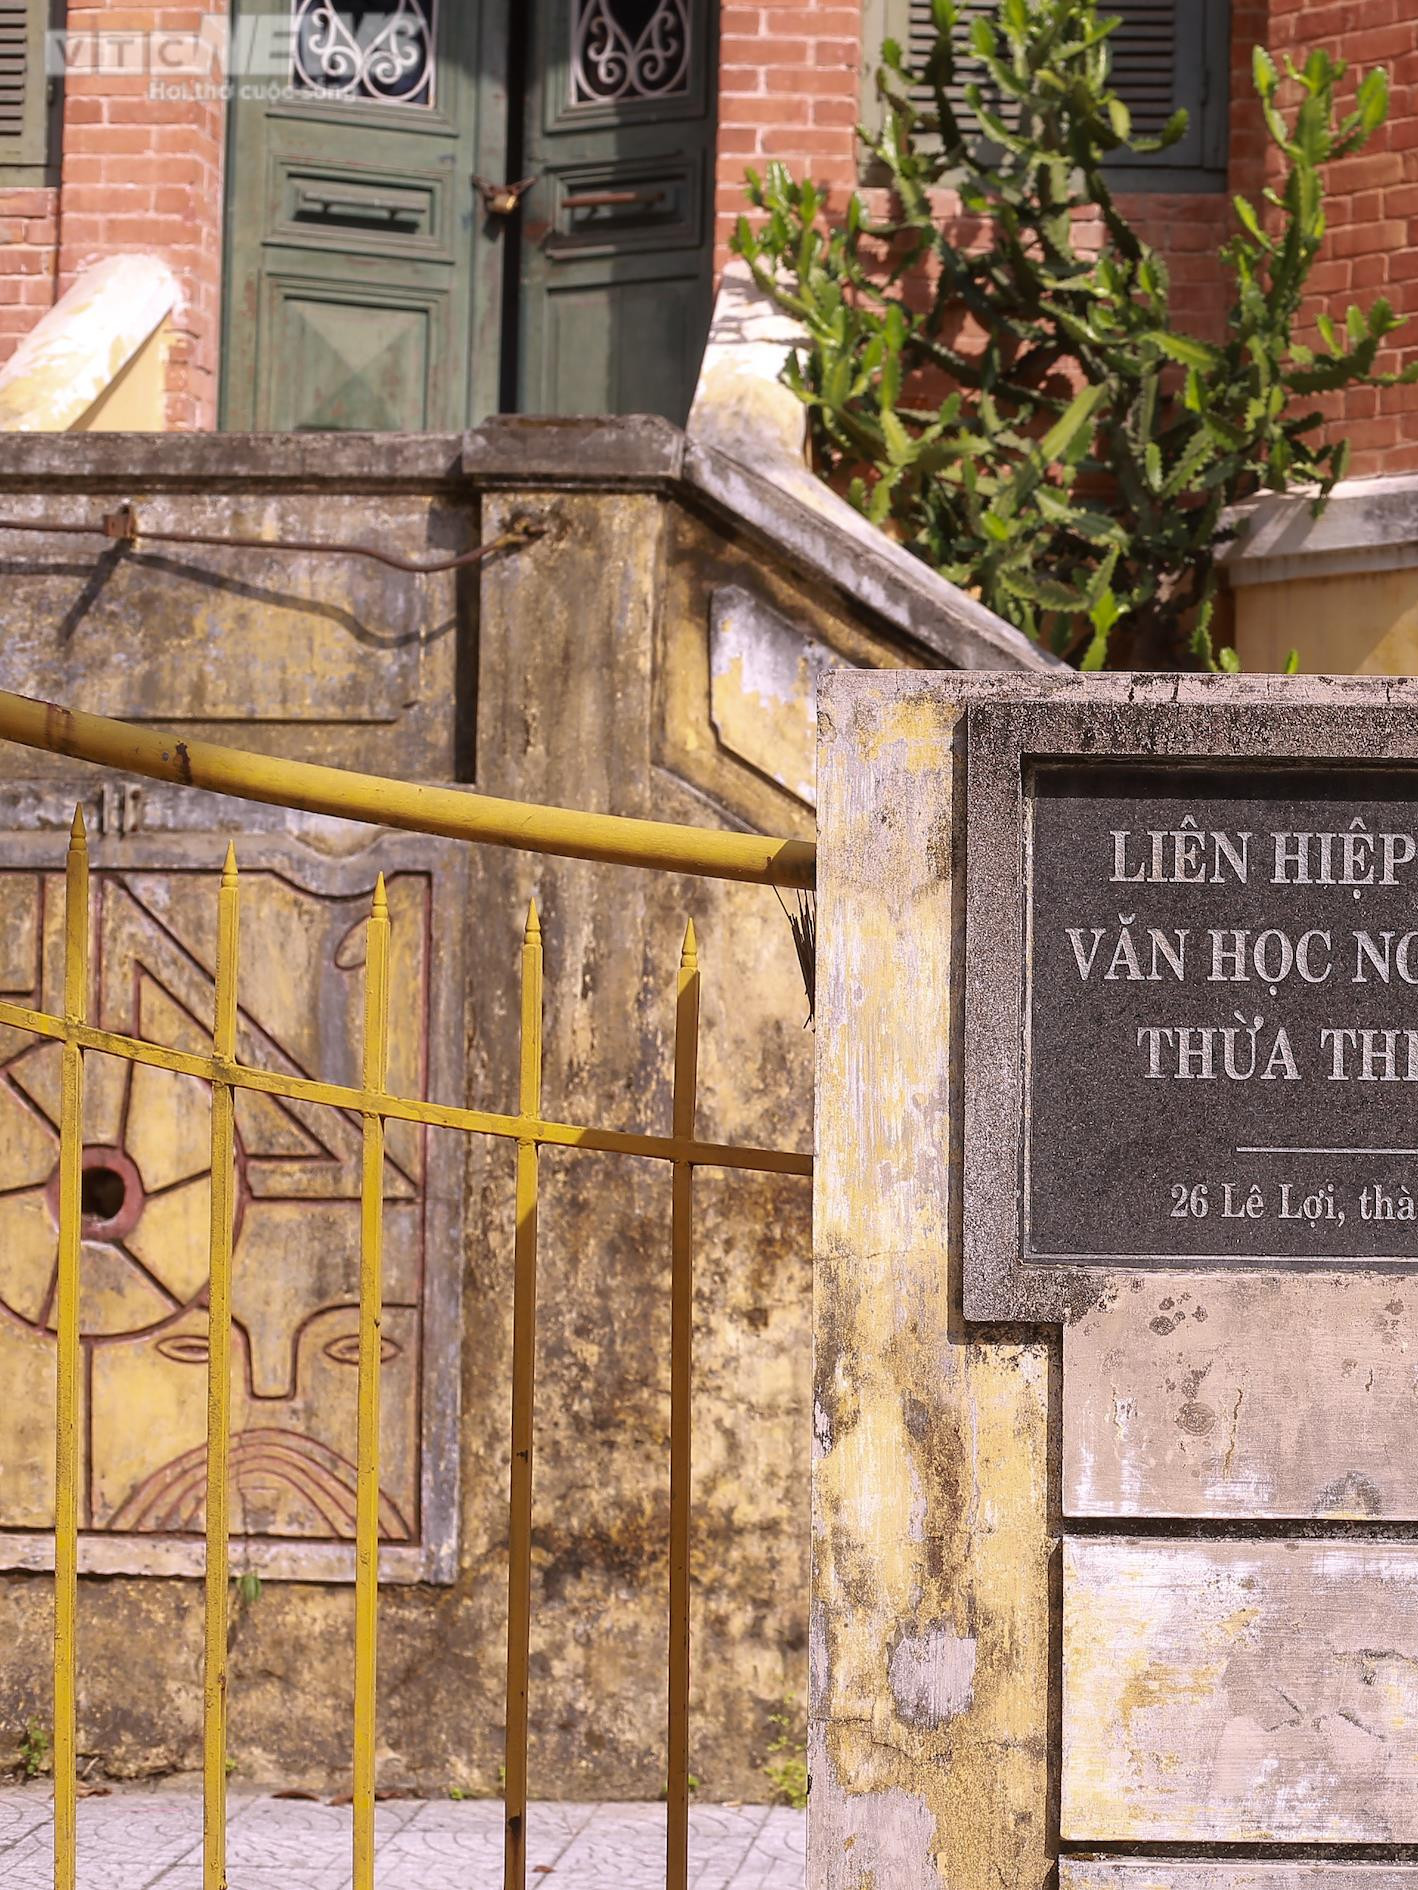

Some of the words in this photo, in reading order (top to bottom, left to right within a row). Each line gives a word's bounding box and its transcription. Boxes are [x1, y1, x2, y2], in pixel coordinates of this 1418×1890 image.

[1109, 815, 1252, 884] LIÊN
[1270, 817, 1417, 900] HIỆP
[1065, 913, 1190, 982] VĂN
[1207, 928, 1333, 996] HỌC
[1137, 1009, 1302, 1081] THỪA
[1169, 1184, 1209, 1218] 26
[1221, 1183, 1265, 1219] Lê
[1278, 1183, 1346, 1228] Lợi,
